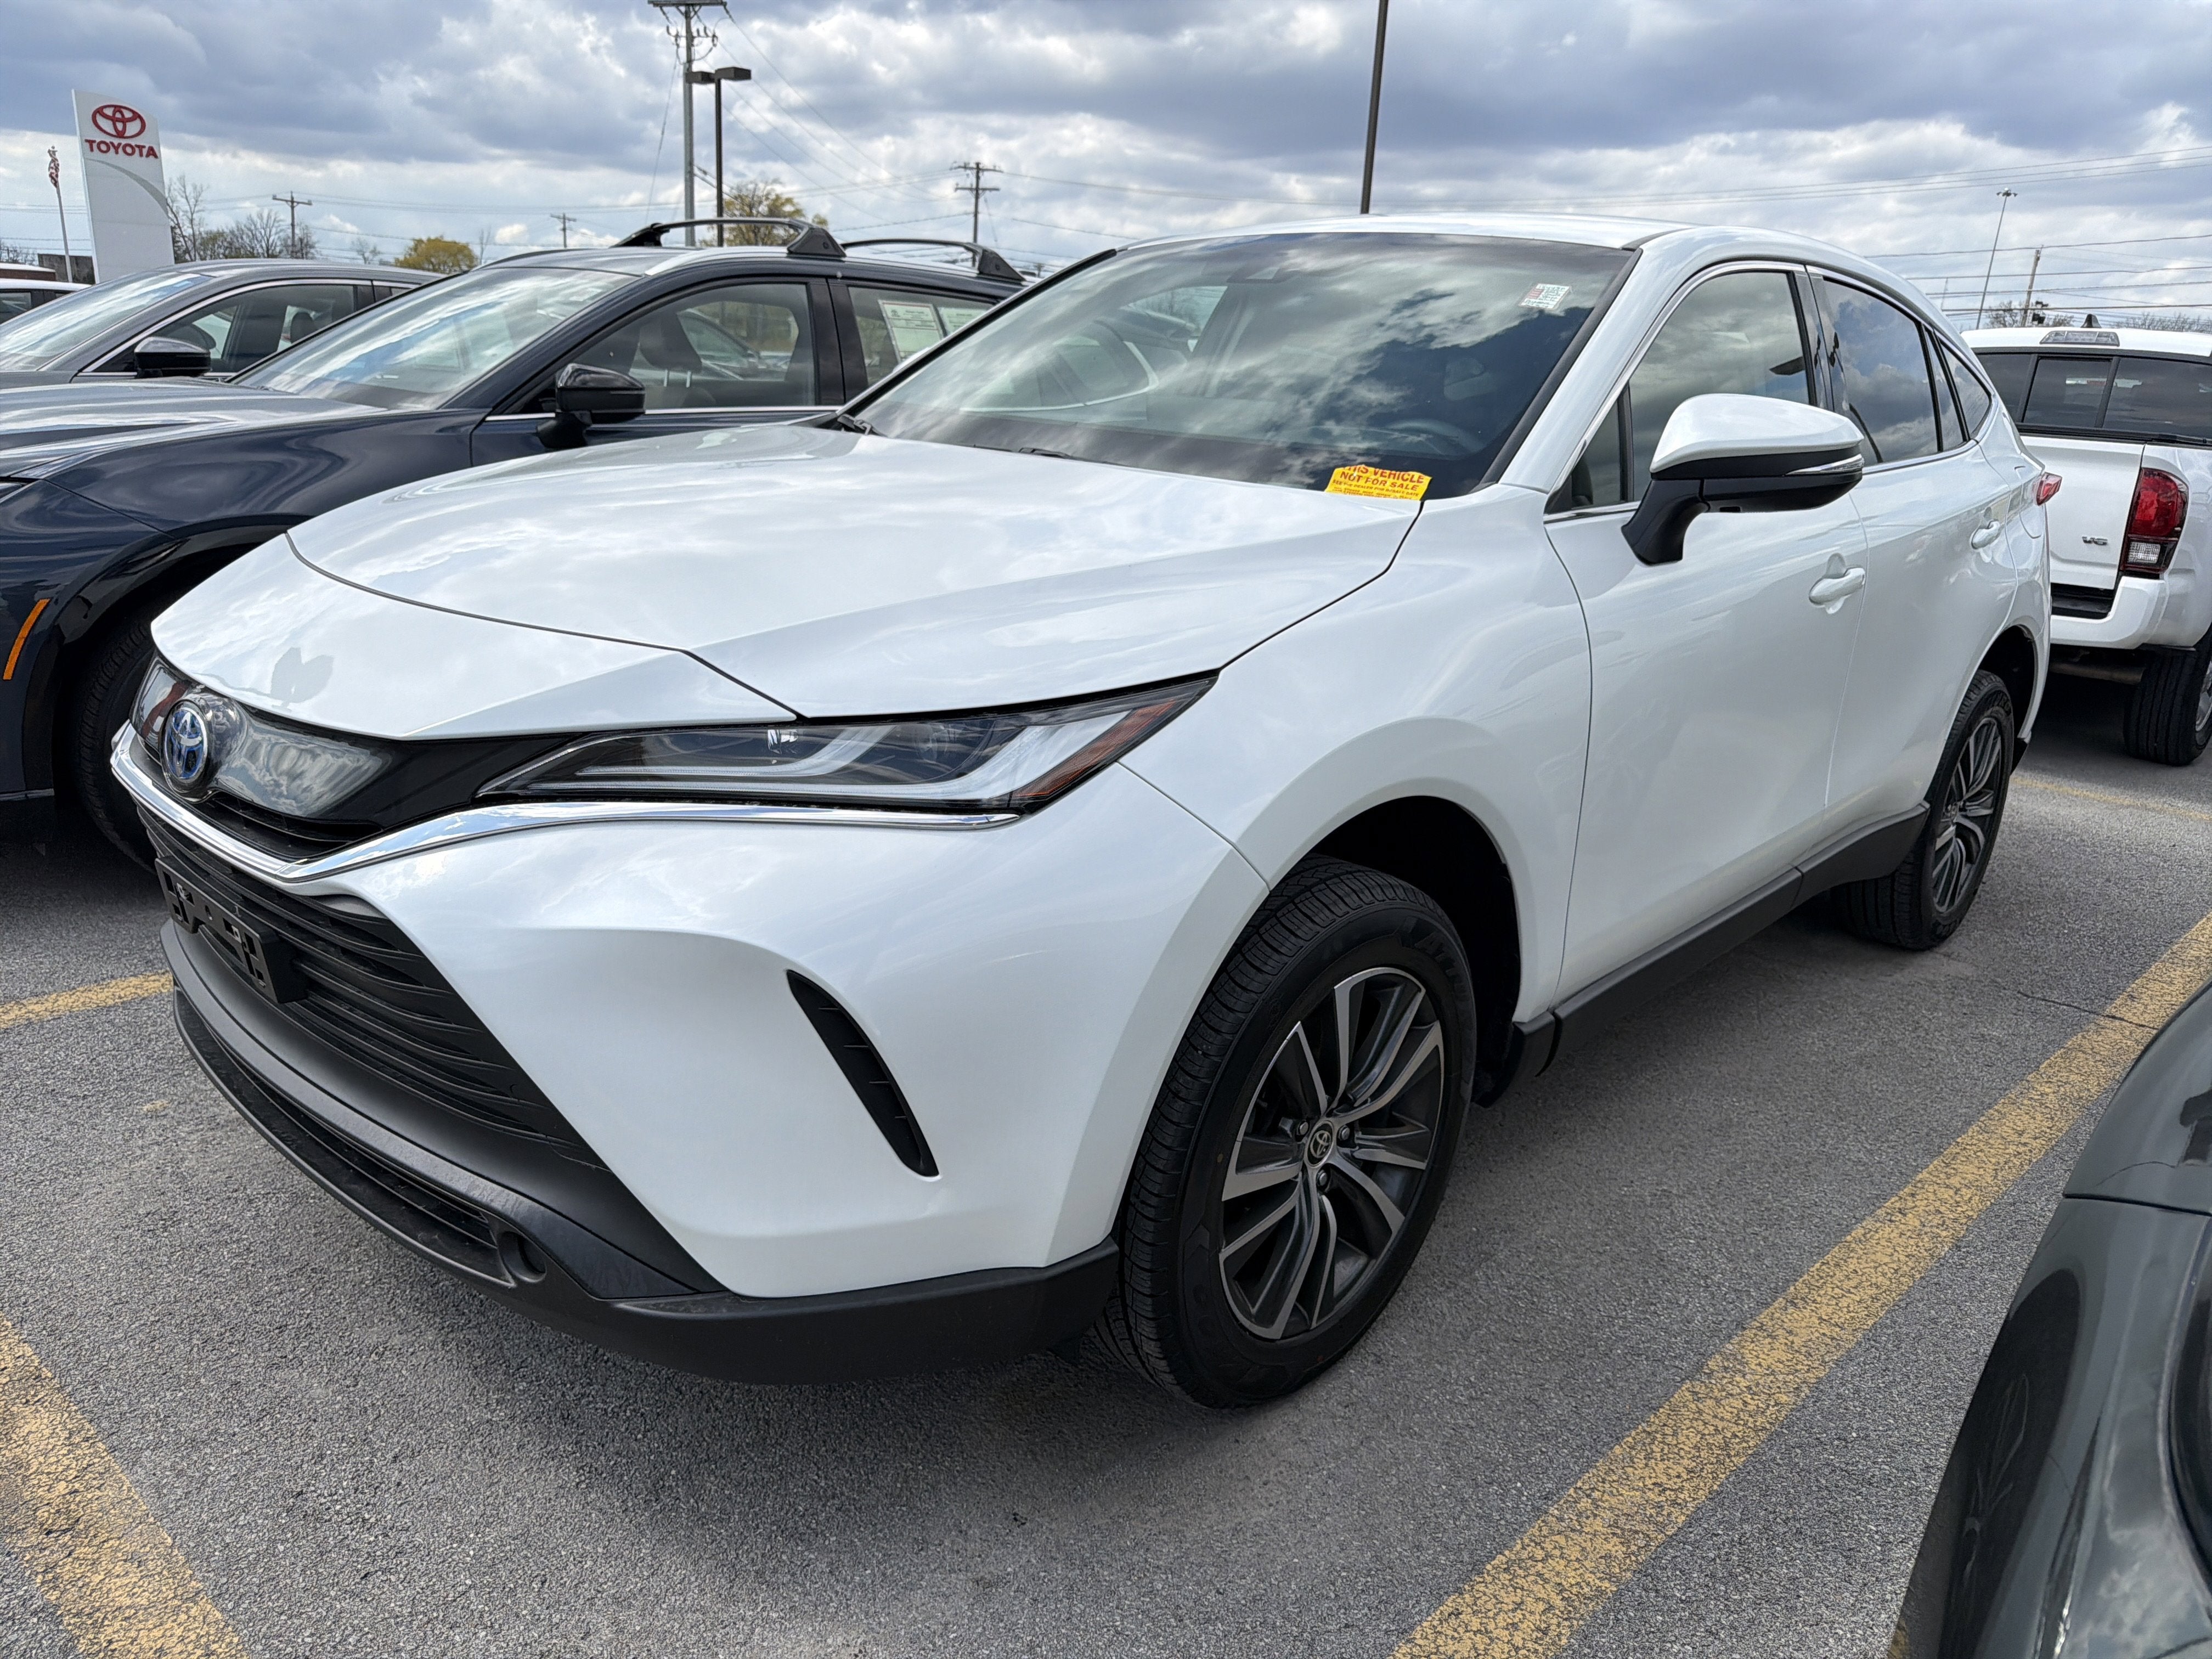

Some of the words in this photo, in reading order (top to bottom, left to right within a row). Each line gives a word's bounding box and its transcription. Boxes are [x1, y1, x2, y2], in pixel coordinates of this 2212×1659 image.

[85, 139, 159, 159] TOYOTA
[1340, 471, 1363, 483] NOT
[1364, 477, 1387, 486] FOR
[1390, 482, 1419, 491] SALE
[1374, 469, 1424, 483] VEHICLE
[2082, 537, 2108, 545] V6
